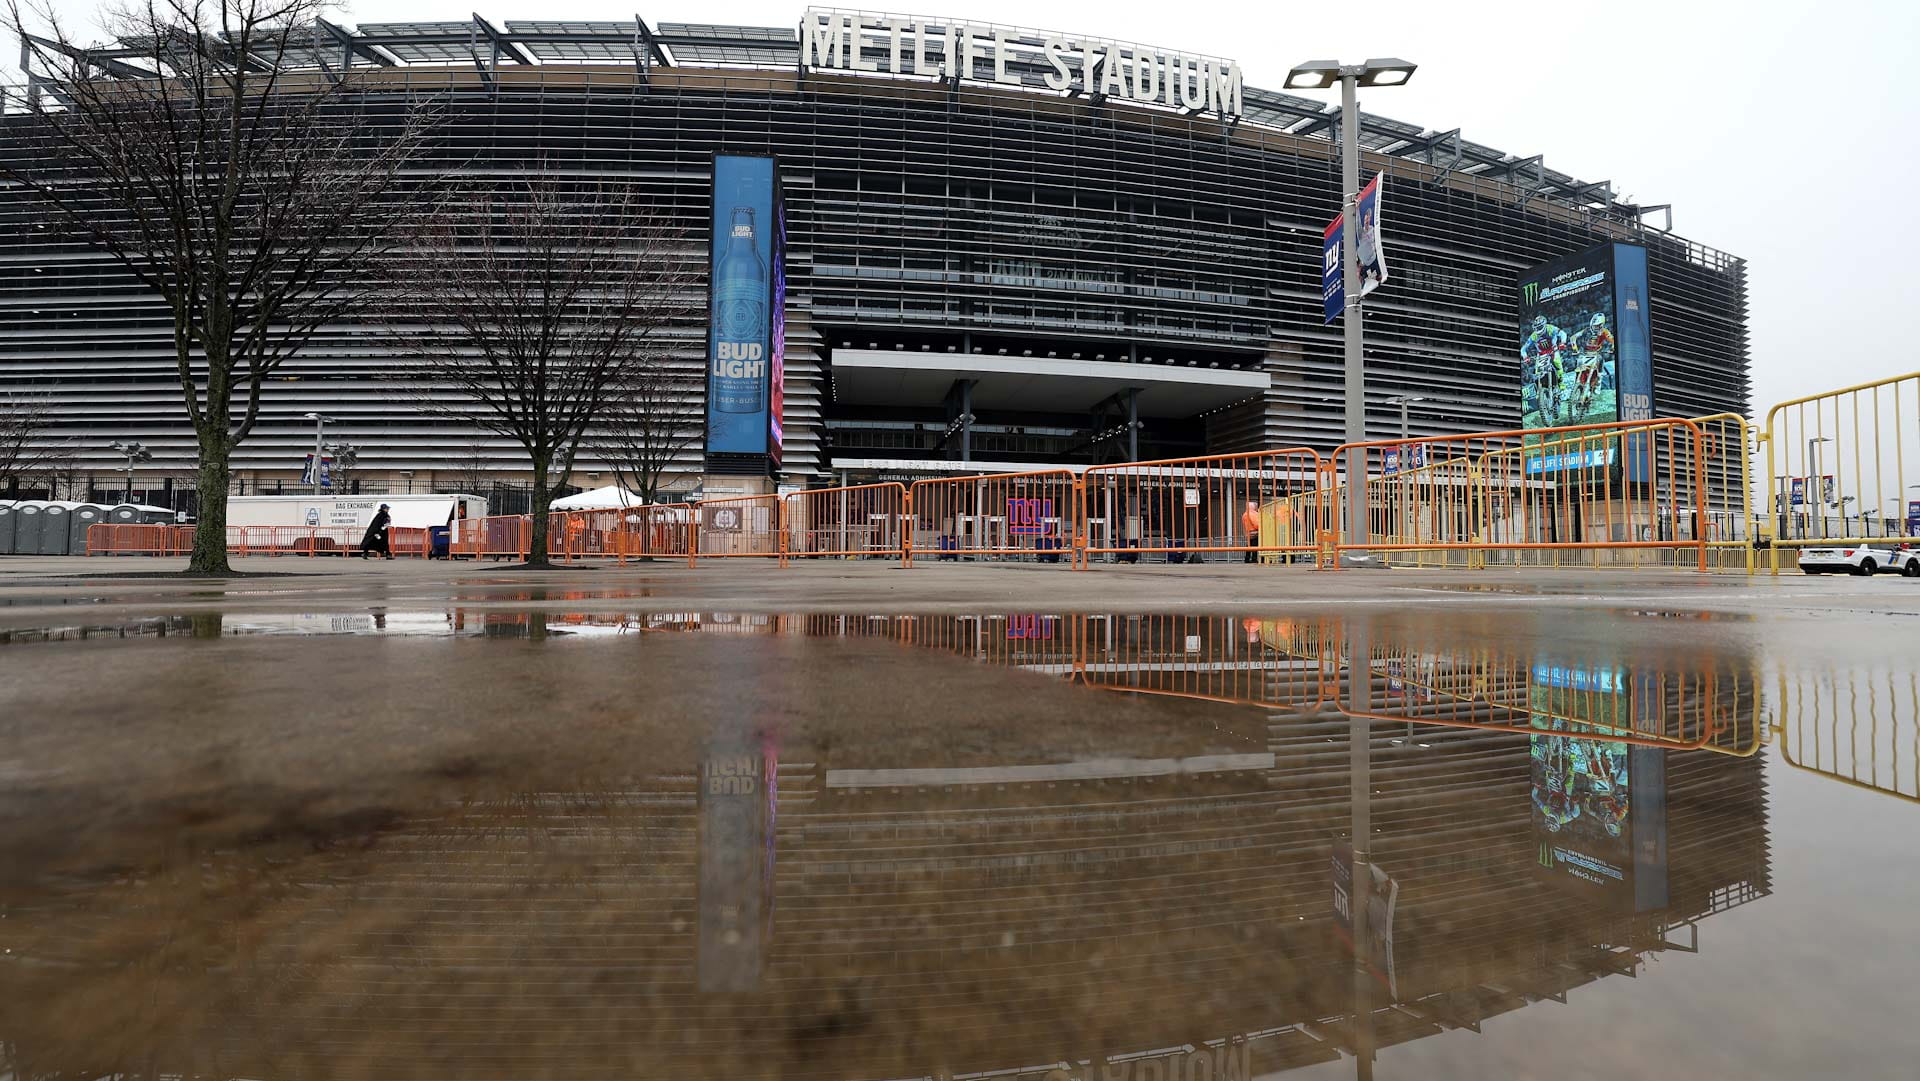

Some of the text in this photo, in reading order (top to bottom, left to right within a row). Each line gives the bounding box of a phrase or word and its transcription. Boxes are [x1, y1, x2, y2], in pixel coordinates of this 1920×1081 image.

[802, 12, 1243, 116] METLIFE STADIUM
[1551, 267, 1587, 283] MONSTER
[717, 341, 762, 360] BUD
[713, 358, 766, 379] LIGHT
[1623, 393, 1649, 408] BUD
[347, 502, 374, 510] EXCHANGE
